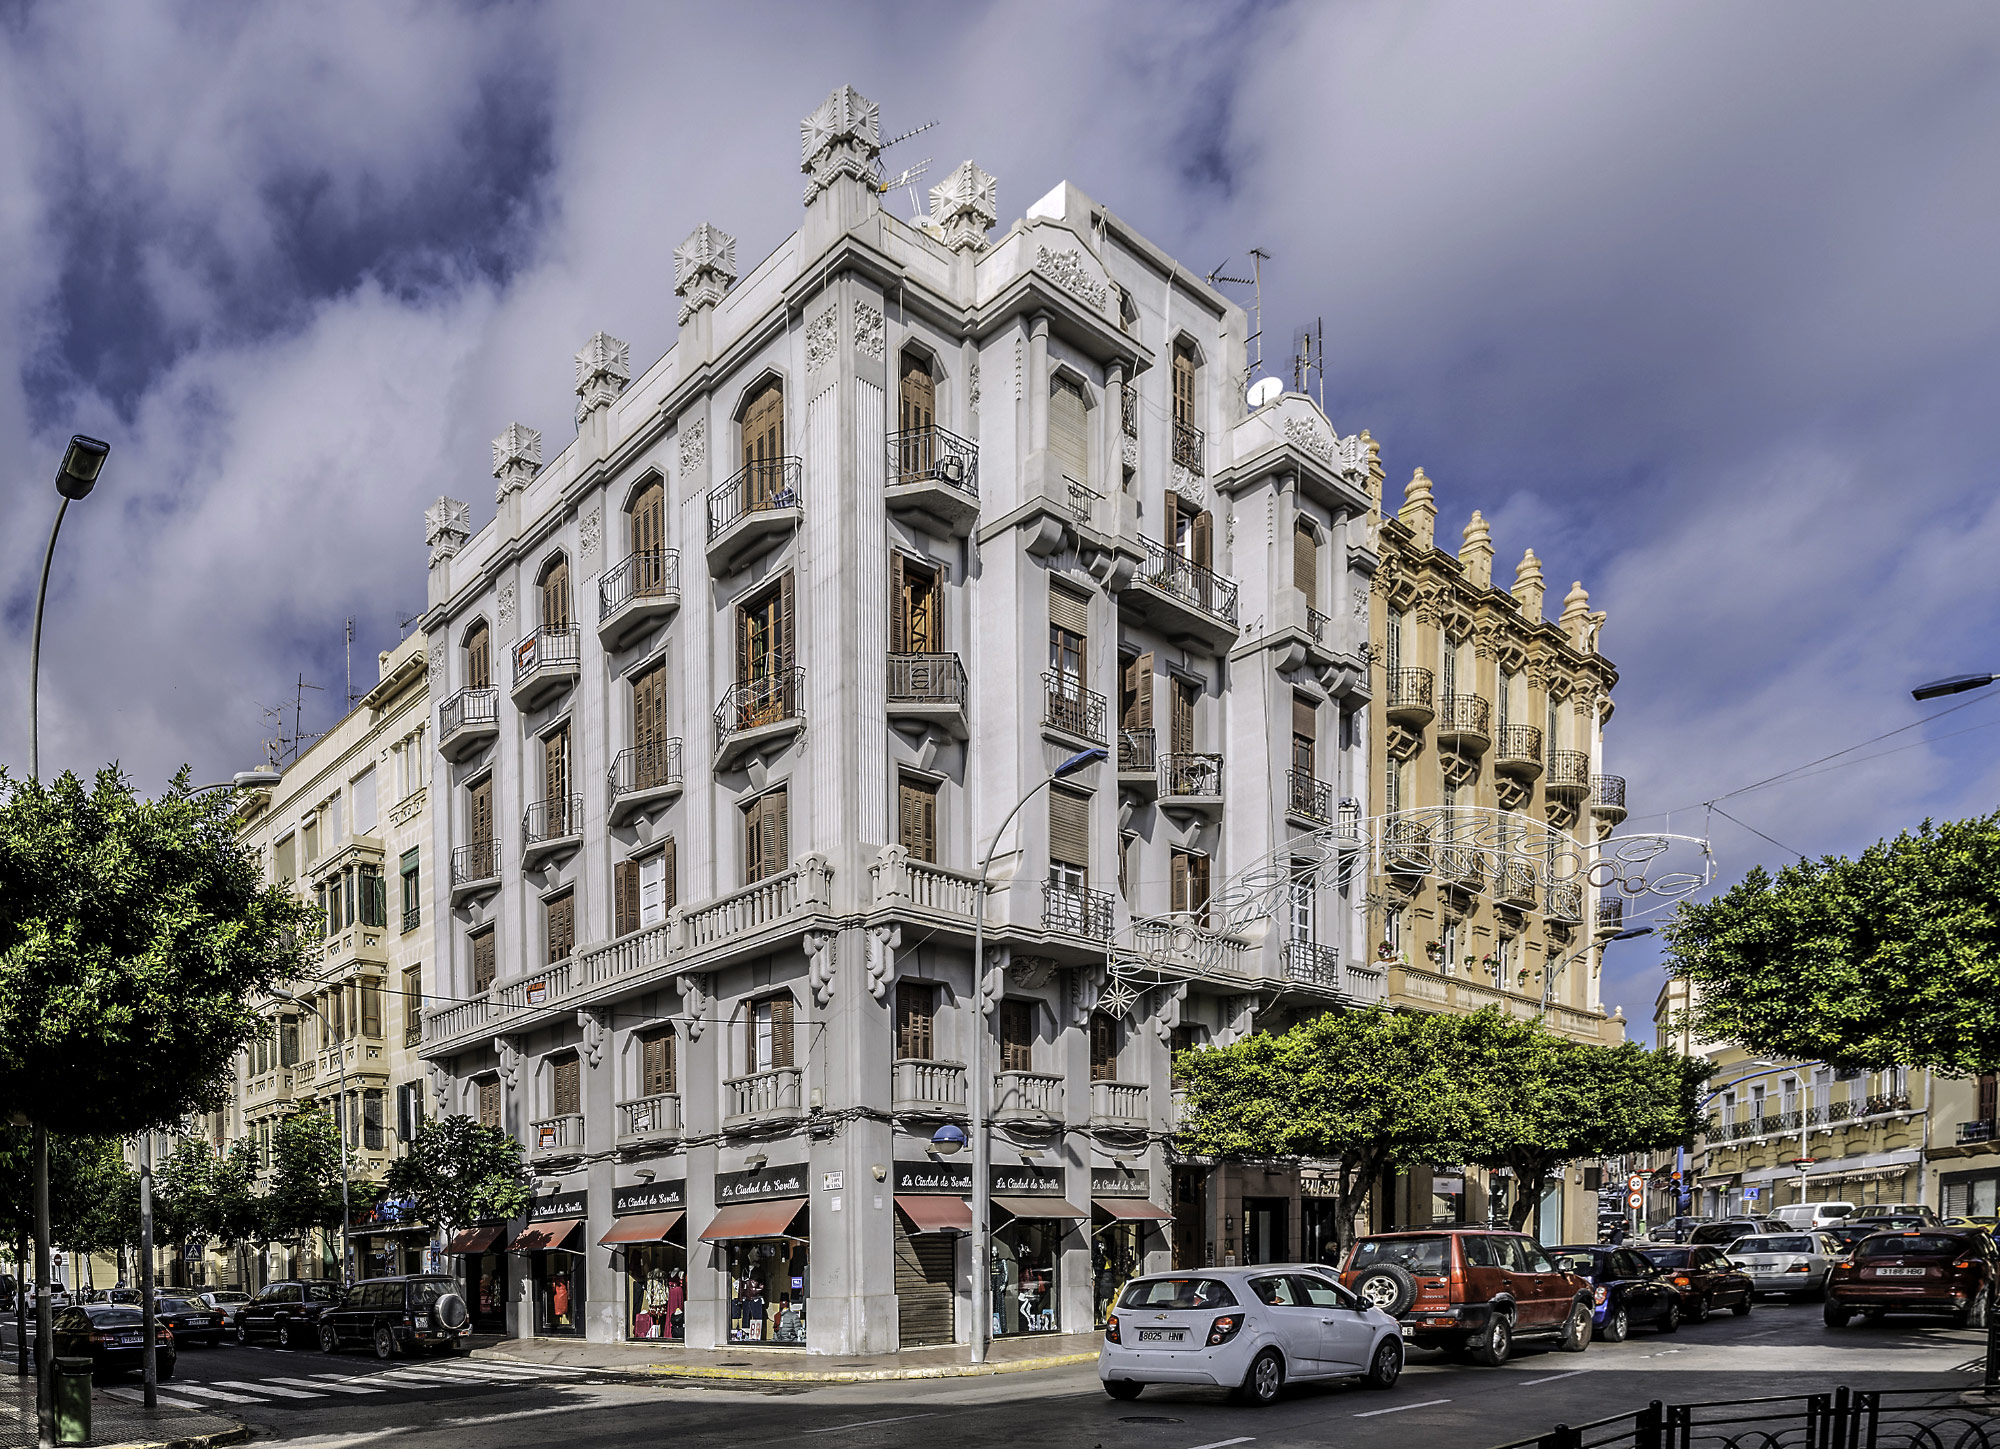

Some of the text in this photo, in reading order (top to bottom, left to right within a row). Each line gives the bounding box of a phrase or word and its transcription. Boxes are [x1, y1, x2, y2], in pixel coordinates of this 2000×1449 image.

[722, 1178, 799, 1196] La Ciudad de Sevilla
[902, 1174, 972, 1187] La Ciudad de Sevilla
[996, 1177, 1058, 1189] La Ciudad de Sevilla
[1092, 1179, 1147, 1191] La Ciudad de Sevilla
[617, 1192, 679, 1208] La Ciudad de Sevilla
[540, 1204, 556, 1215] Ciudad
[557, 1204, 564, 1213] de
[565, 1202, 582, 1212] Sevilla
[1143, 1332, 1183, 1341] 8025 HNW
